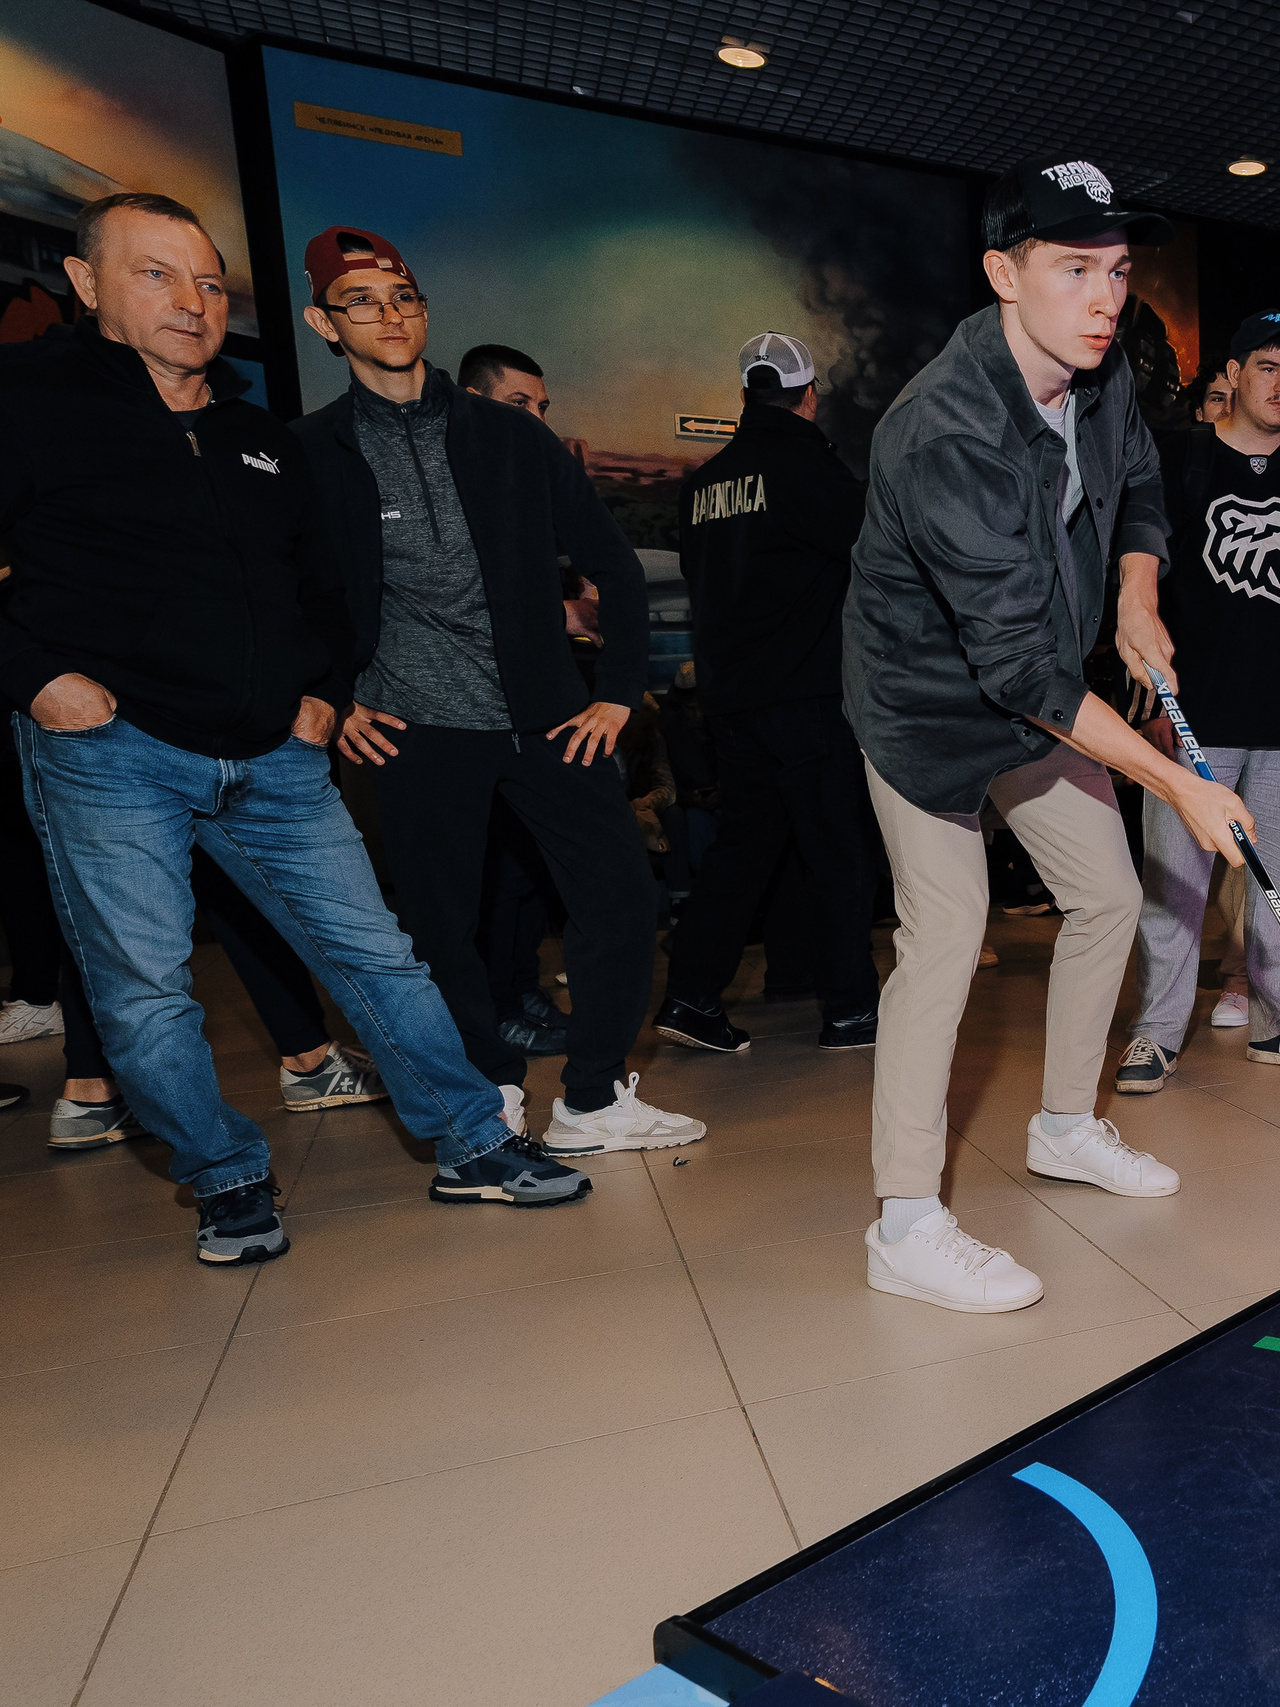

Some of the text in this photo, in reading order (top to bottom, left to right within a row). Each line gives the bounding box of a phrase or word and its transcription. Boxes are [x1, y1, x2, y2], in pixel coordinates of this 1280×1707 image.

[241, 453, 277, 475] PUMA
[692, 474, 767, 526] BALENCIAGA
[1232, 826, 1245, 842] FLEX
